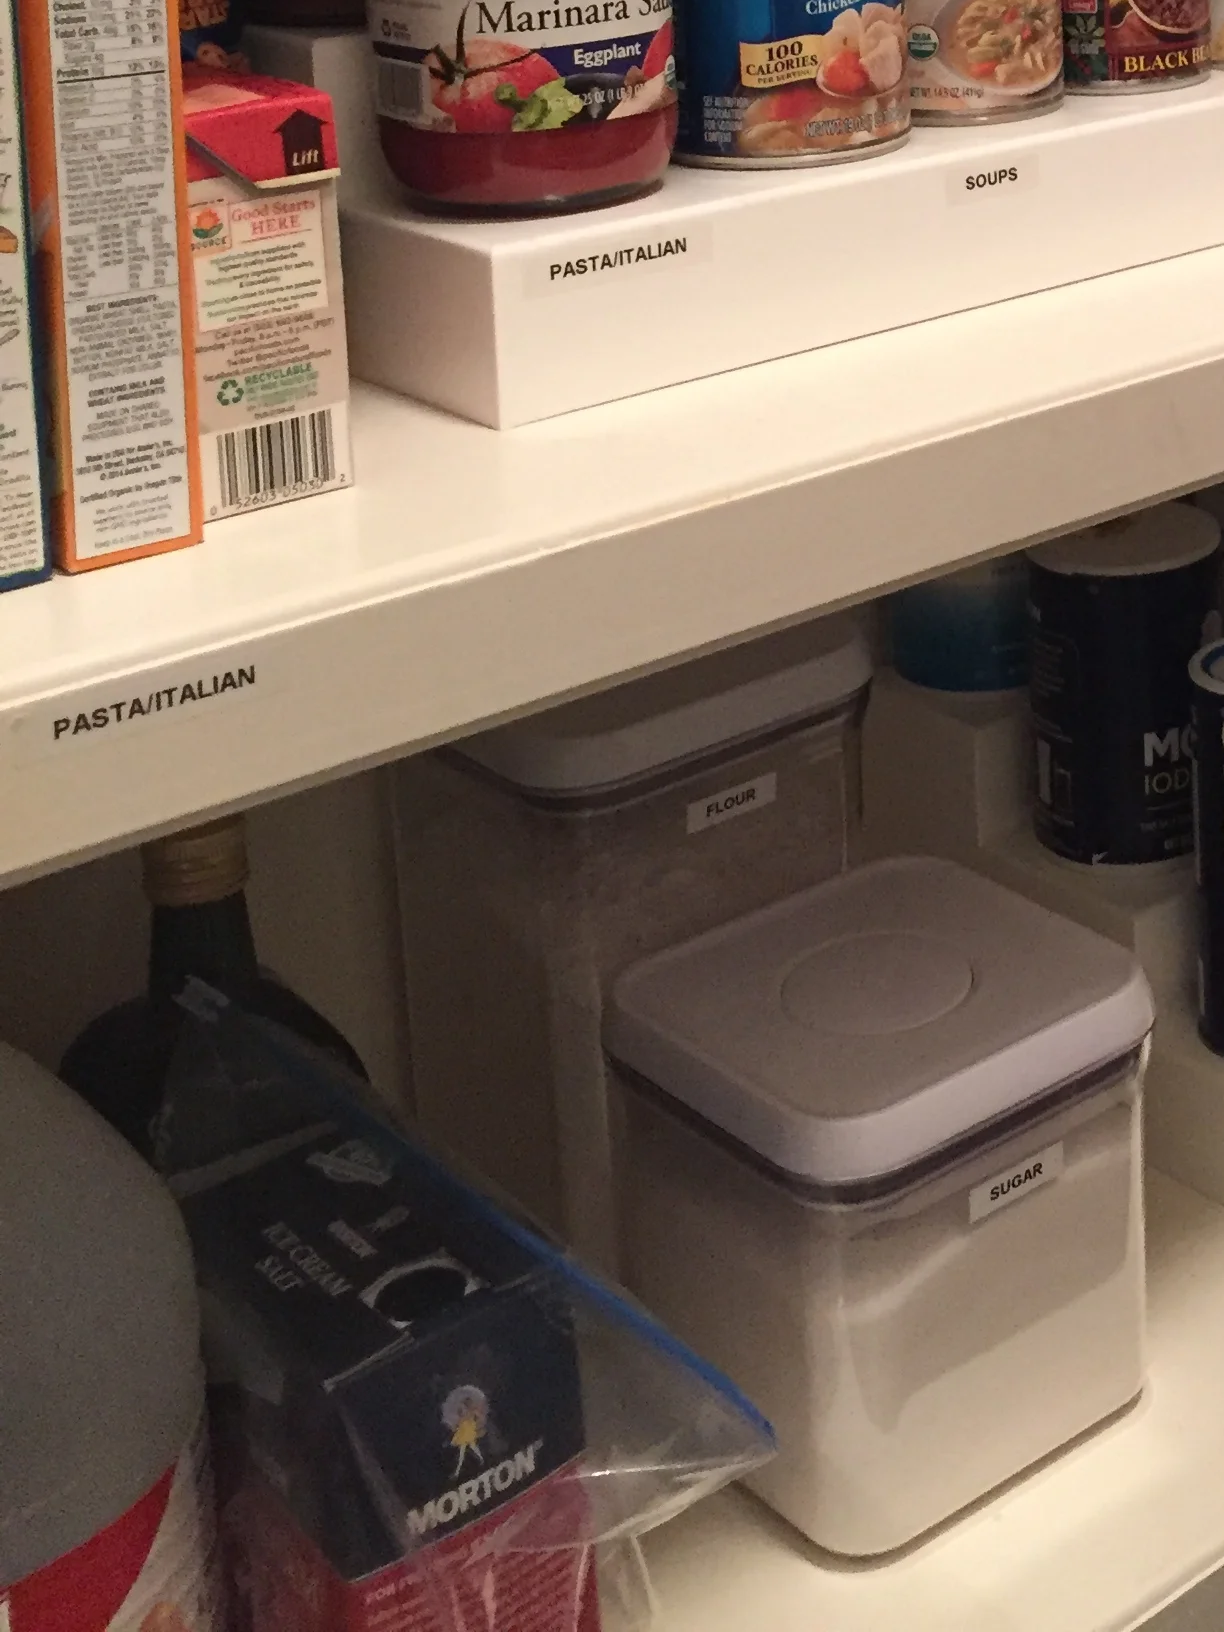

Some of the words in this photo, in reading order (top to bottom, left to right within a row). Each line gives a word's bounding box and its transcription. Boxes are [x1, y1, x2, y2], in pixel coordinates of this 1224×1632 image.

[573, 41, 642, 69] Eggplant
[766, 39, 803, 59] 100
[746, 53, 819, 78] CALORIES
[1124, 53, 1188, 74] BLACK
[292, 149, 319, 167] Lift
[965, 167, 1019, 191] SOUPS
[232, 204, 270, 222] Good
[250, 215, 301, 236] HERE
[549, 237, 688, 281] PASTA/ITALIAN
[210, 504, 217, 517] 0
[236, 489, 277, 510] 52603
[283, 476, 325, 498] 05030
[340, 472, 346, 483] 2
[53, 665, 256, 739] PASTA/ITALIAN
[705, 787, 757, 818] FLOUR
[989, 1161, 1044, 1203] SUGAR
[406, 1452, 539, 1535] MORTON
